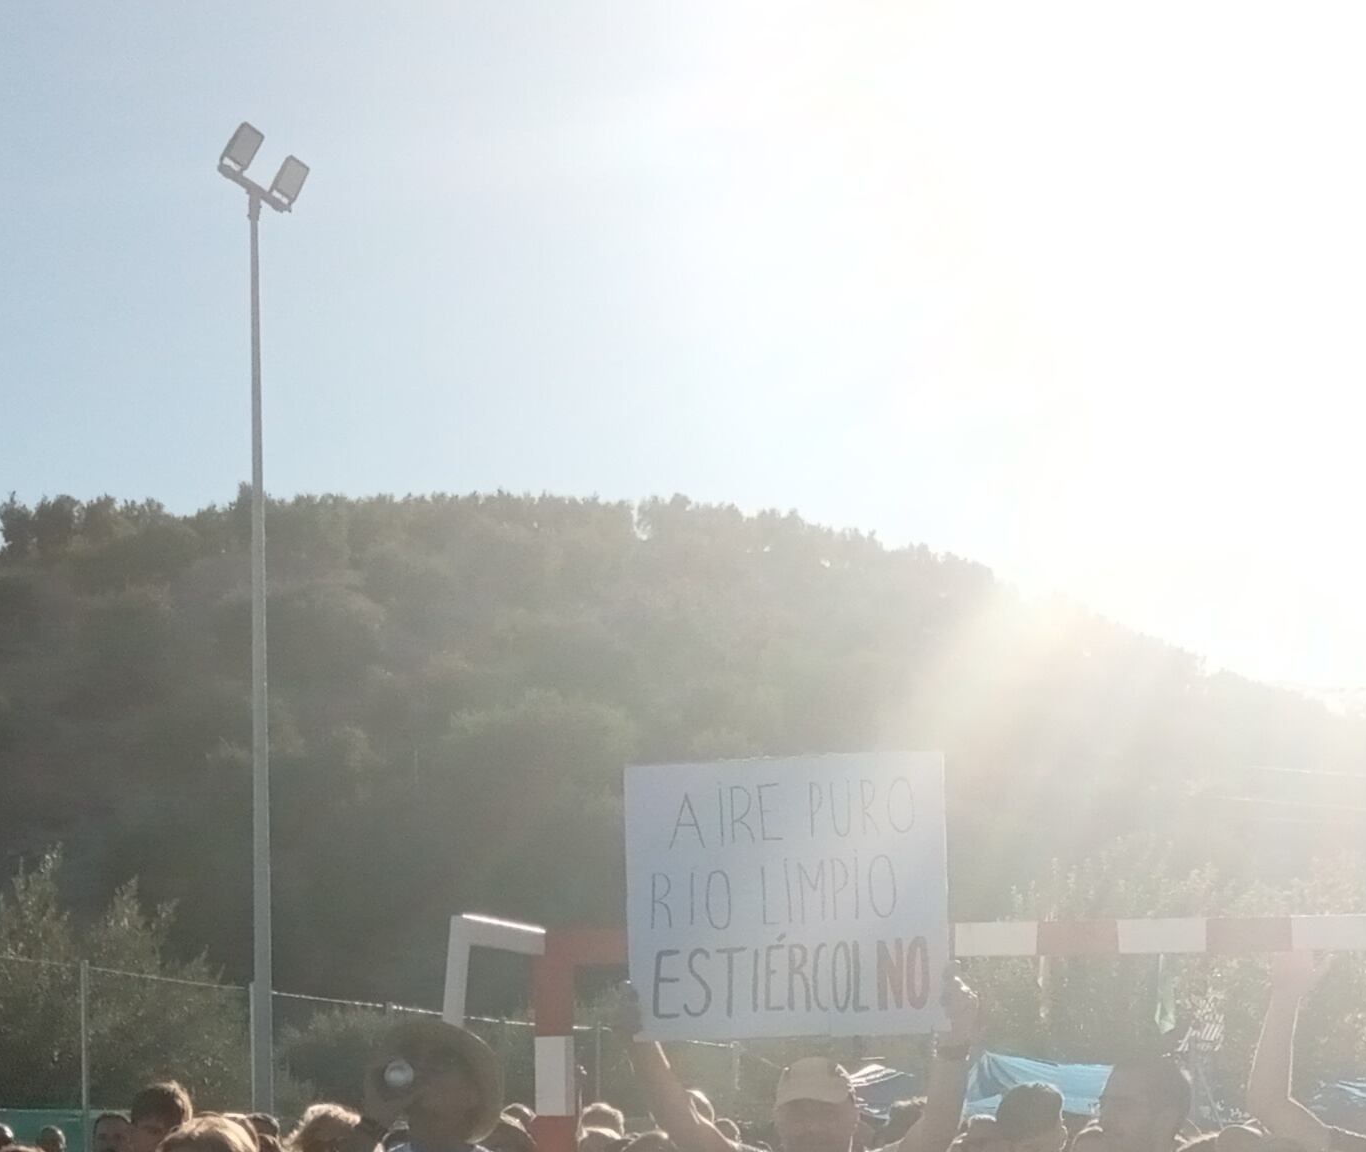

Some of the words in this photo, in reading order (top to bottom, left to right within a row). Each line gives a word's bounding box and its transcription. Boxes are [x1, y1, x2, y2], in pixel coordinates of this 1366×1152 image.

[669, 782, 784, 850] AIRE
[809, 776, 916, 838] PURO
[651, 869, 732, 930] RIO
[761, 849, 897, 925] LIMPIO
[651, 933, 870, 1020] ESTIÉRCOL
[876, 936, 931, 1012] NO
